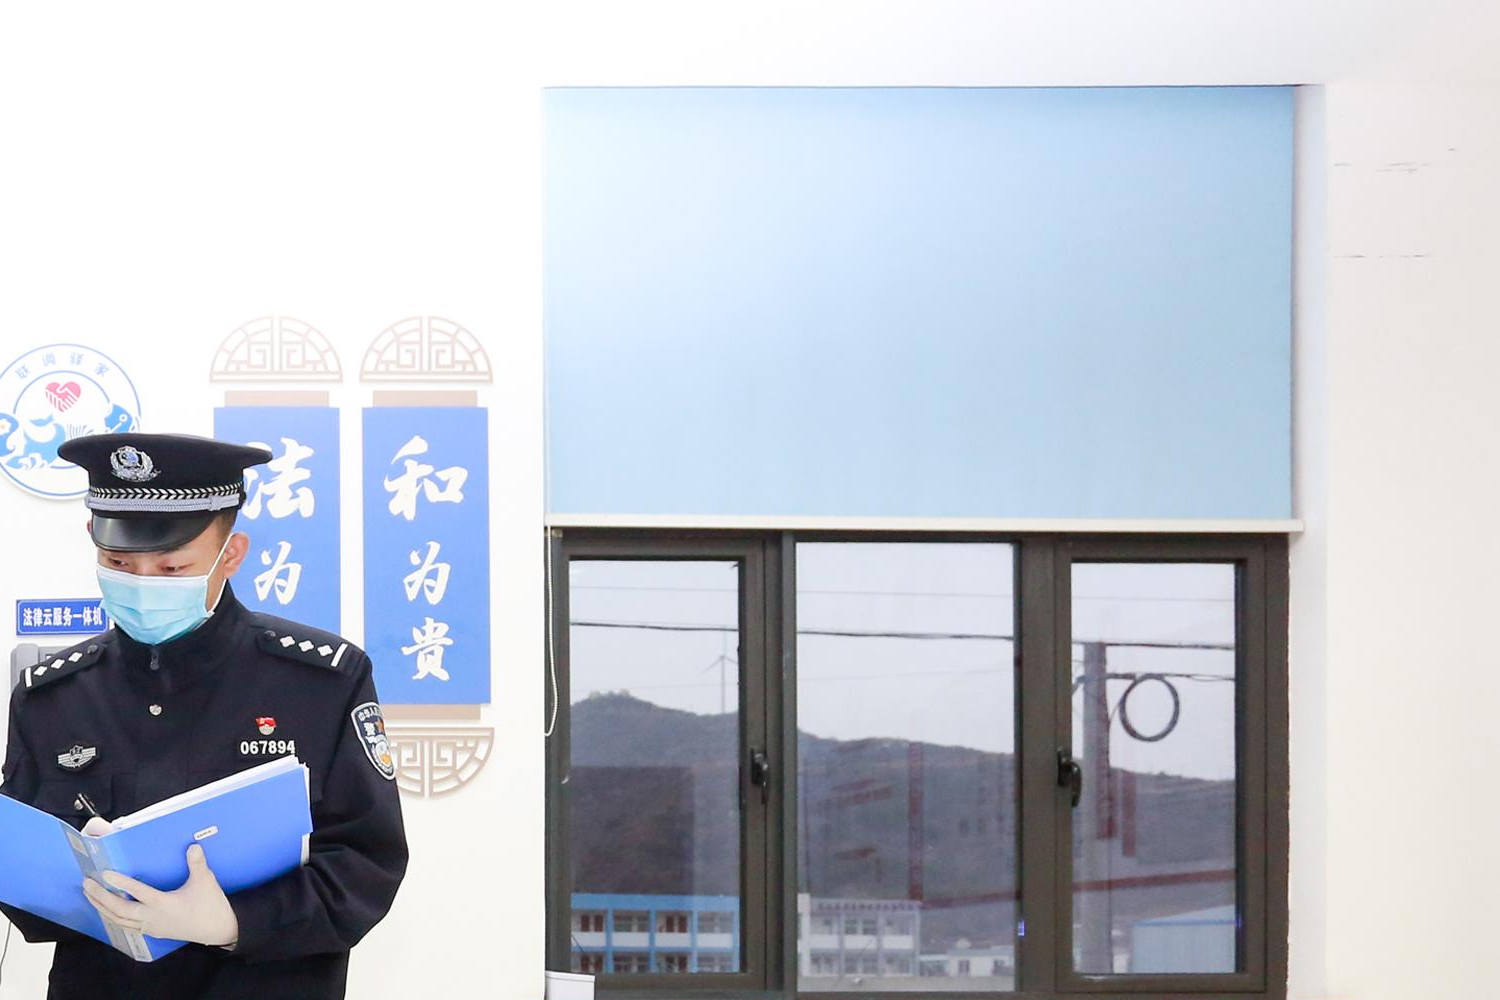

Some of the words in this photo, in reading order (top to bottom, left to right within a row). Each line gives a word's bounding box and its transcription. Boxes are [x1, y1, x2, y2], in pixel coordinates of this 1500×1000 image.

[23, 606, 103, 626] 法律云服务一体机
[240, 740, 296, 755] 067894
